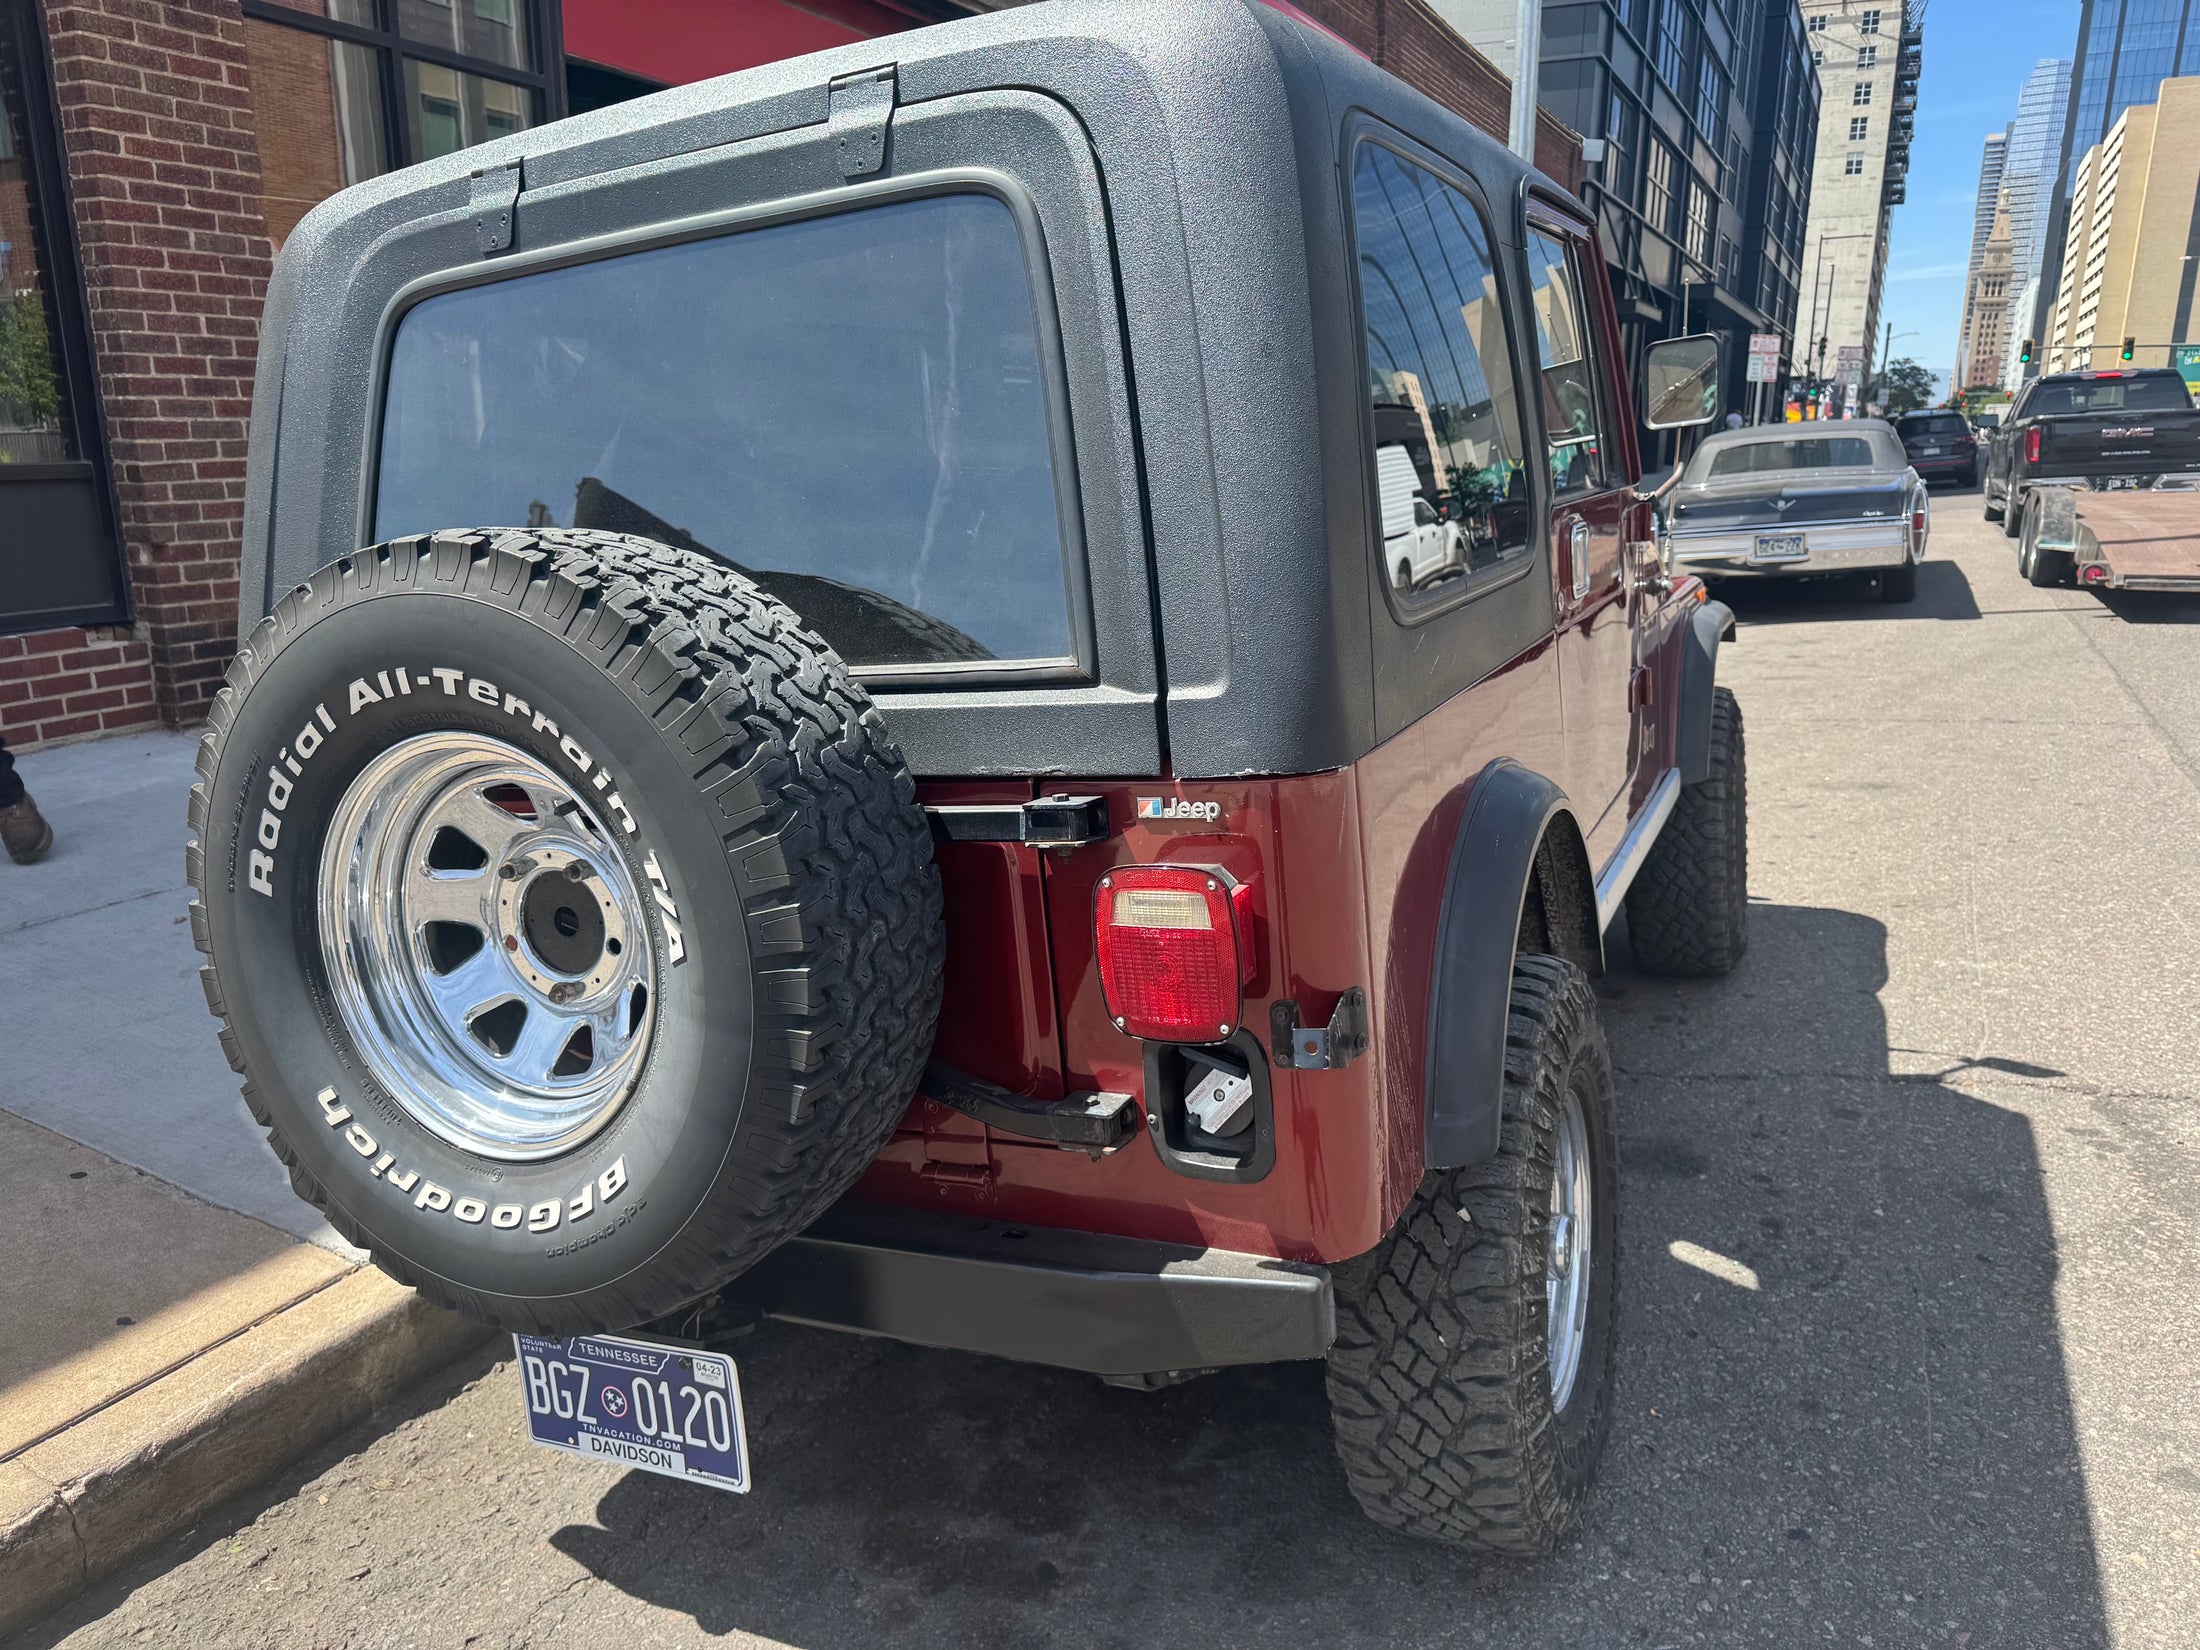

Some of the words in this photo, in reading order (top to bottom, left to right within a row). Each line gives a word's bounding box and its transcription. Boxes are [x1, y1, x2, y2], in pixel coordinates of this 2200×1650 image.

[248, 703, 336, 897] Radial
[348, 667, 639, 834] All-Terrain
[642, 849, 686, 965] T/A
[1163, 797, 1221, 822] Jeep
[317, 1086, 628, 1231] BFGoodrich
[522, 1344, 543, 1353] STATE
[578, 1342, 658, 1367] TENNESSEE
[696, 1361, 721, 1376] 04-23
[525, 1356, 597, 1424] BGZ
[631, 1377, 730, 1452] 0120
[582, 1423, 682, 1451] TNVACATION.COM
[591, 1437, 672, 1469] DAVIDSON
